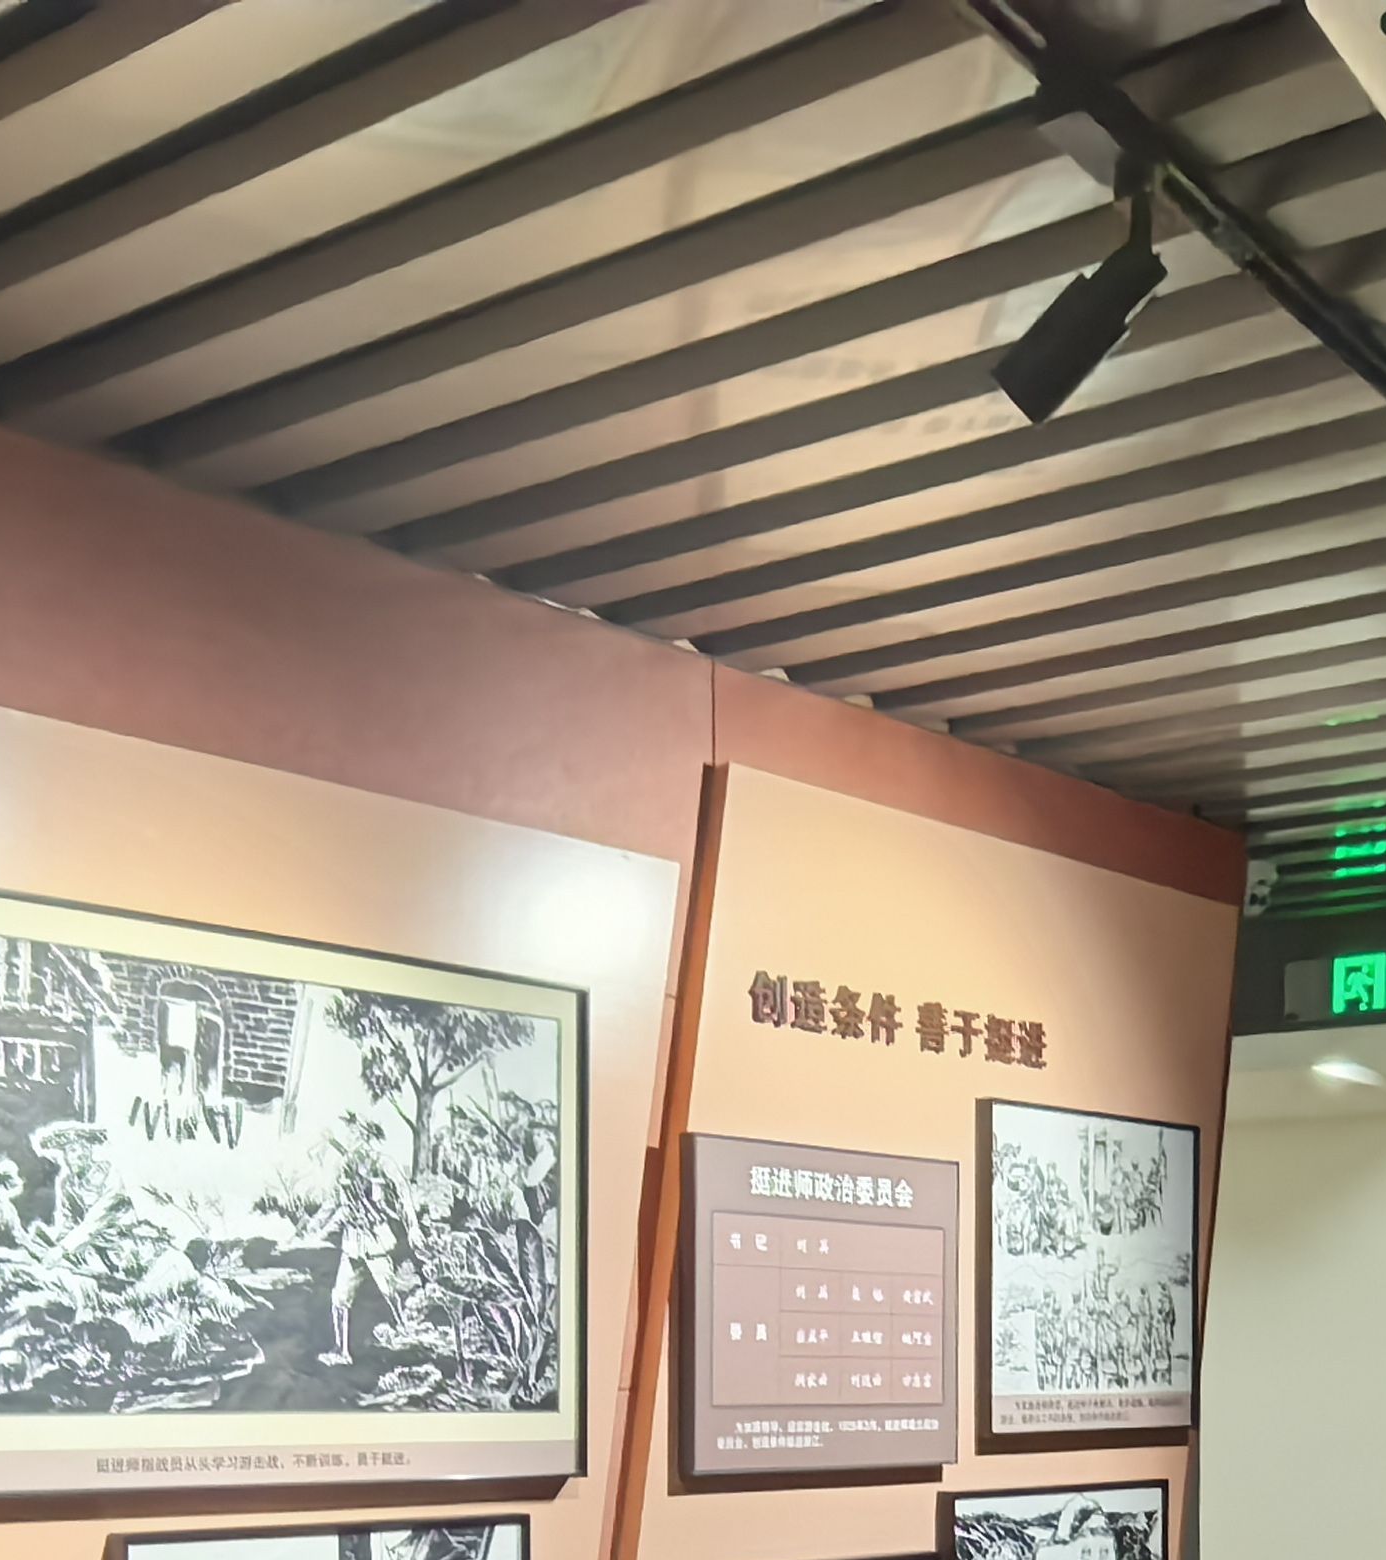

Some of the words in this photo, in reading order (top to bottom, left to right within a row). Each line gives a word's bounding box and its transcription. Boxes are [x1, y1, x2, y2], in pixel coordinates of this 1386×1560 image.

[748, 969, 903, 1047] 创造条件
[915, 1001, 1047, 1070] 善于挺进
[749, 1165, 914, 1209] 挺进师政治委员会
